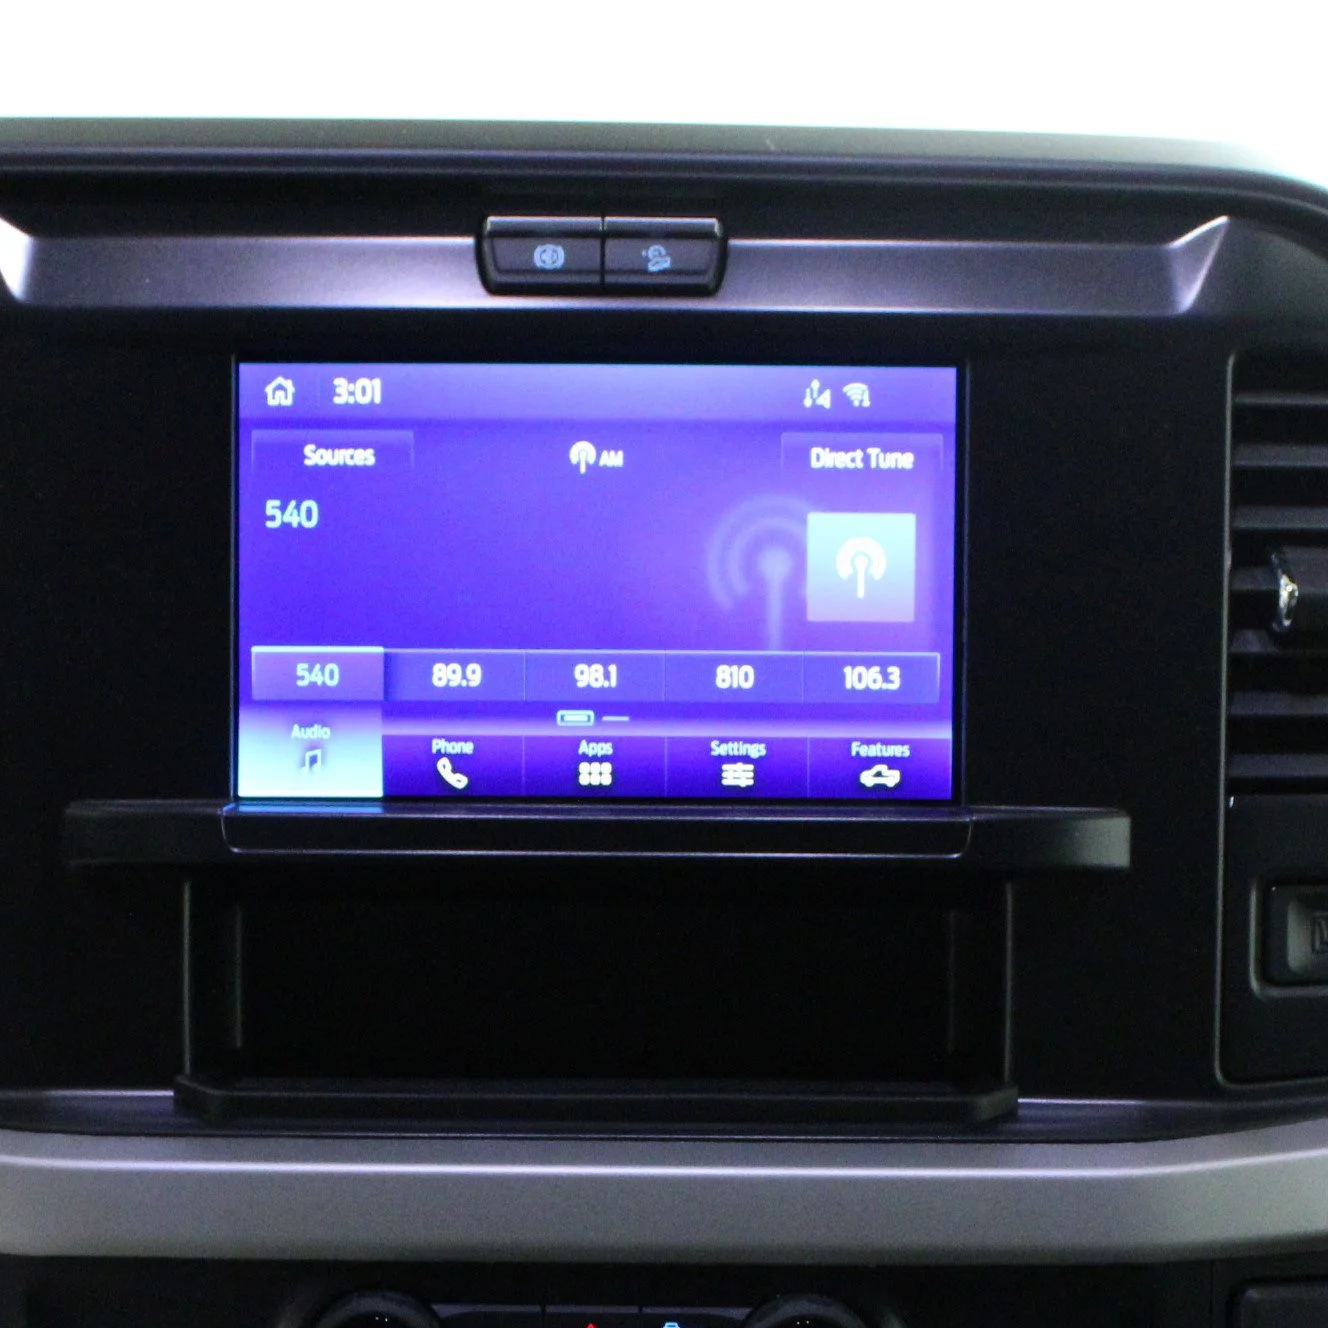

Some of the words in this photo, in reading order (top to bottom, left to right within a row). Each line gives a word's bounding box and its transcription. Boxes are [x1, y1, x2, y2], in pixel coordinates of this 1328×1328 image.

[332, 377, 382, 405] 3:01
[303, 443, 376, 466] Sources
[598, 450, 624, 468] AM
[810, 447, 864, 469] Direct
[866, 447, 915, 470] Tune
[265, 499, 319, 529] 540
[296, 662, 340, 687] 540
[431, 662, 482, 688] 89.9
[573, 663, 617, 689] 98.1
[715, 664, 755, 689] 810
[843, 665, 901, 691] 106.3
[290, 724, 331, 741] Audio
[432, 739, 474, 755] Phone
[579, 740, 614, 758] Apps
[711, 741, 767, 759] Settings
[850, 741, 911, 758] Features
